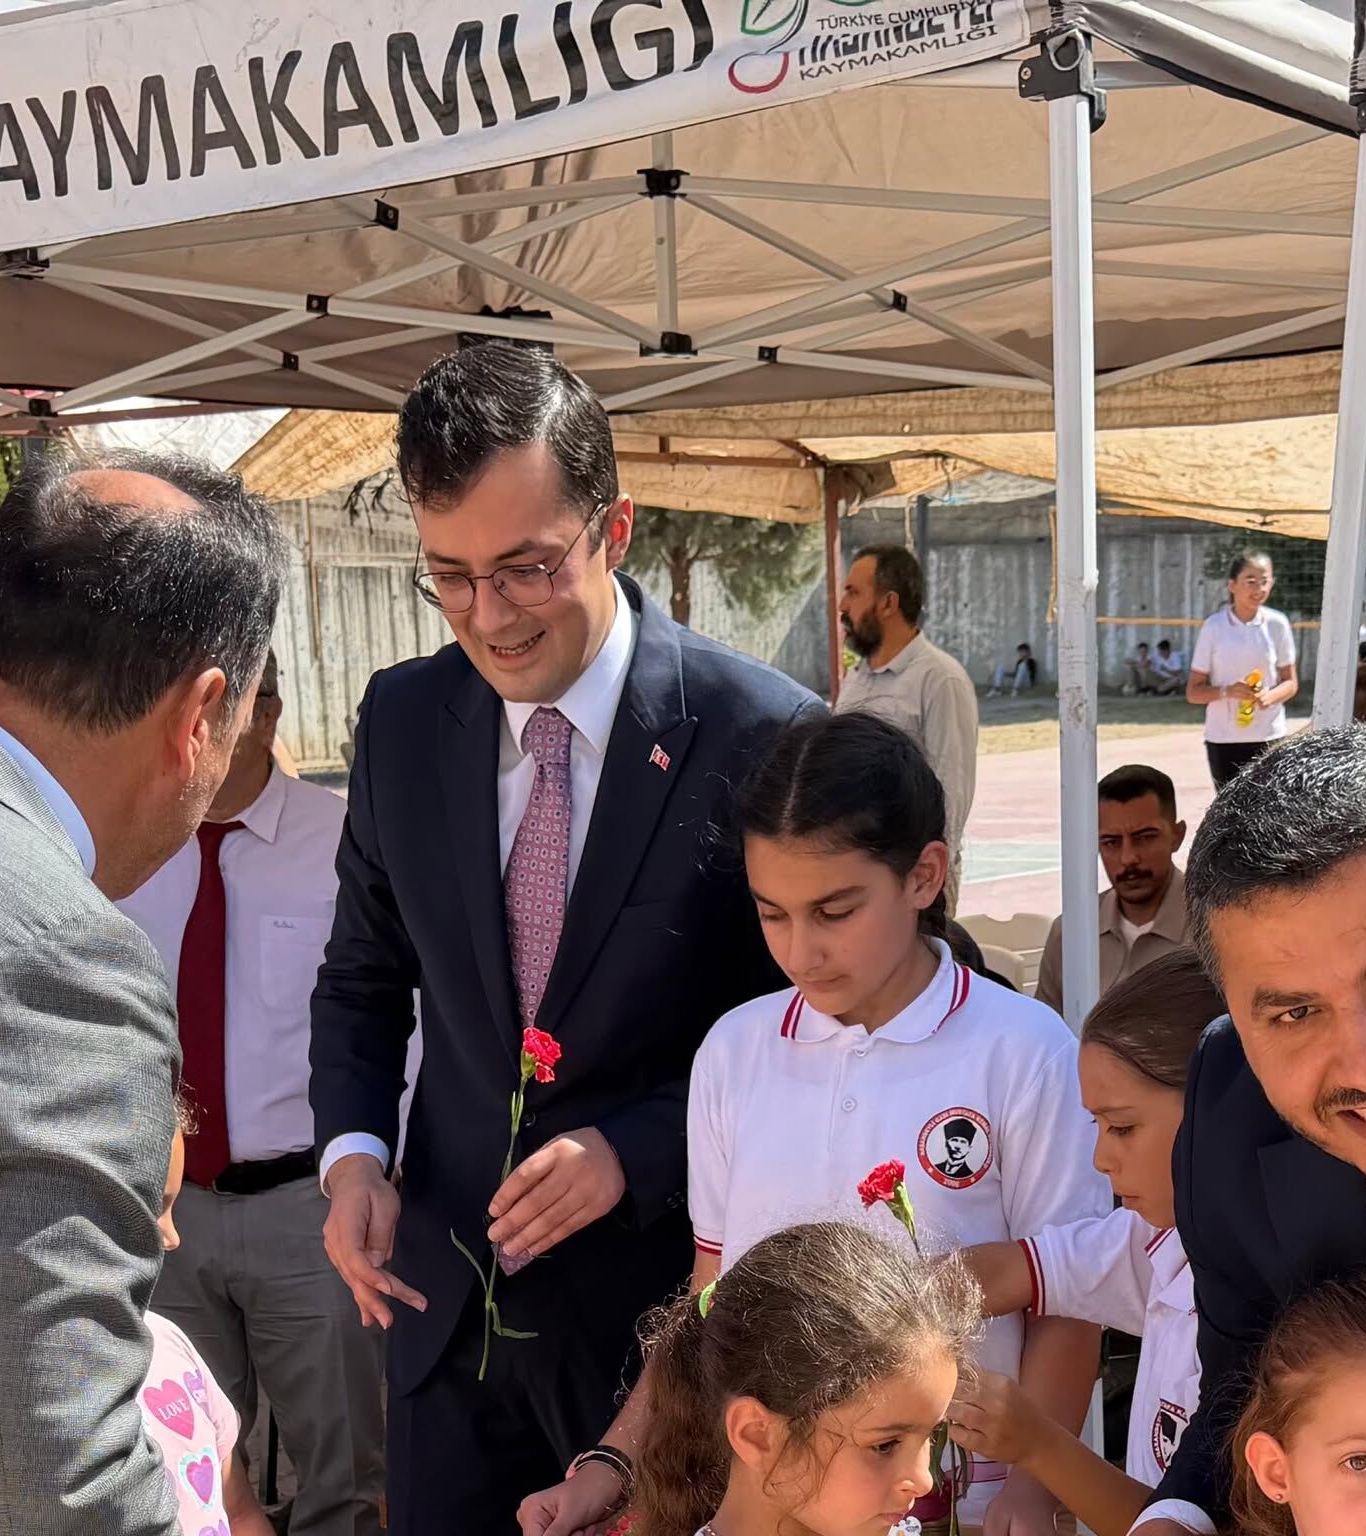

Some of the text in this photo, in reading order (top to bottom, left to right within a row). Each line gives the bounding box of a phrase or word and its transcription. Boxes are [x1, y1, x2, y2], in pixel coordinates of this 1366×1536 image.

[817, 12, 885, 31] TÜRKİYE
[799, 24, 998, 81] KAYMAKAMLIĞI
[157, 1398, 191, 1421] LOVE
